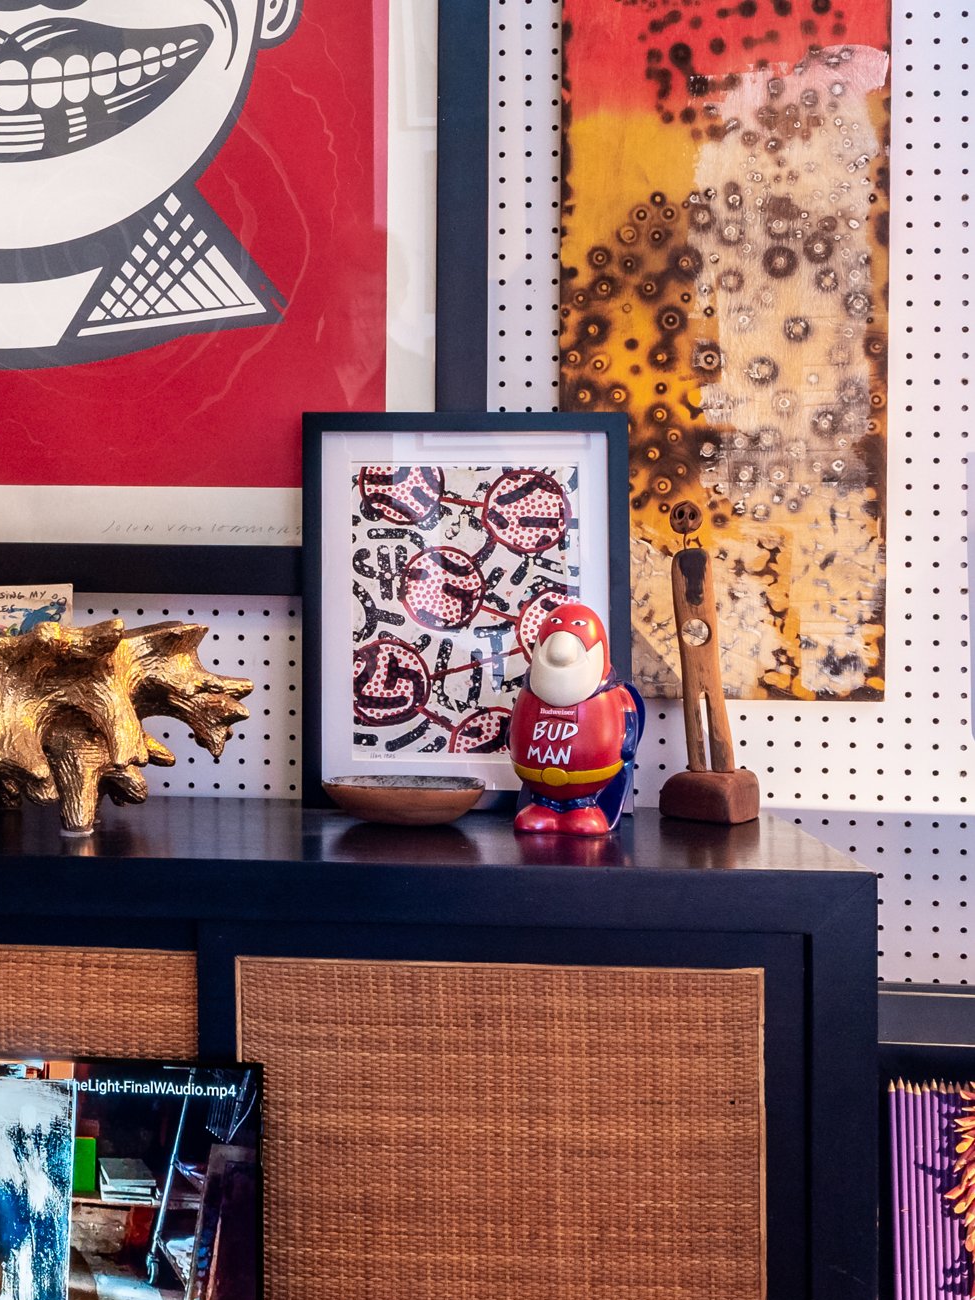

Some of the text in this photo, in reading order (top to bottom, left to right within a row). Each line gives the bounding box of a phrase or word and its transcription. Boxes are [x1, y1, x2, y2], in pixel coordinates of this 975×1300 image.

[30, 590, 46, 602] MY
[540, 708, 575, 716] Budweiser
[533, 721, 579, 742] BUD
[527, 745, 572, 765] MAN
